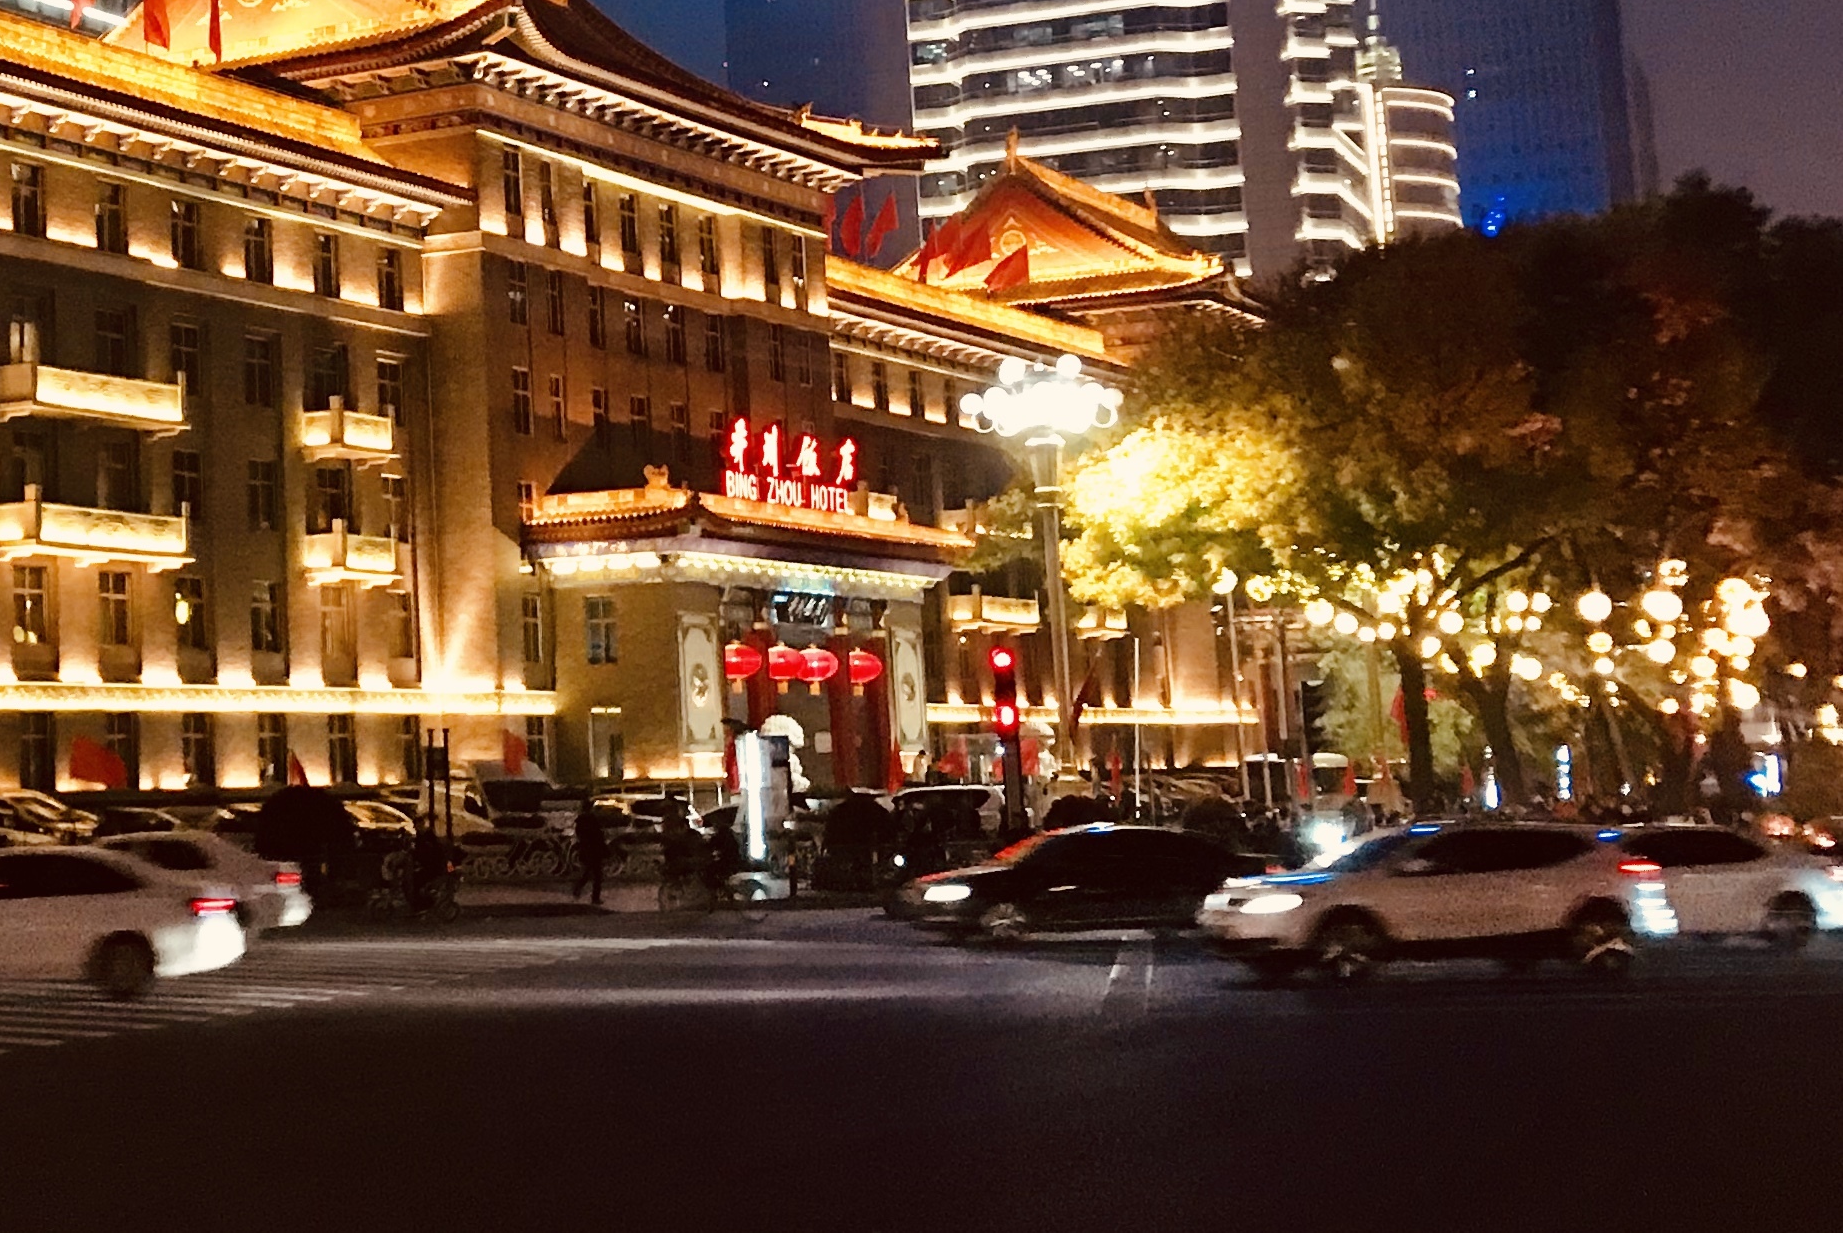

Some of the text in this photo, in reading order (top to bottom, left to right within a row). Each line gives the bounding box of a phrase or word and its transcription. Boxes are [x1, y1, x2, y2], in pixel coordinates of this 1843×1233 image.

[725, 470, 855, 515] BING ZHOU HOTEL
